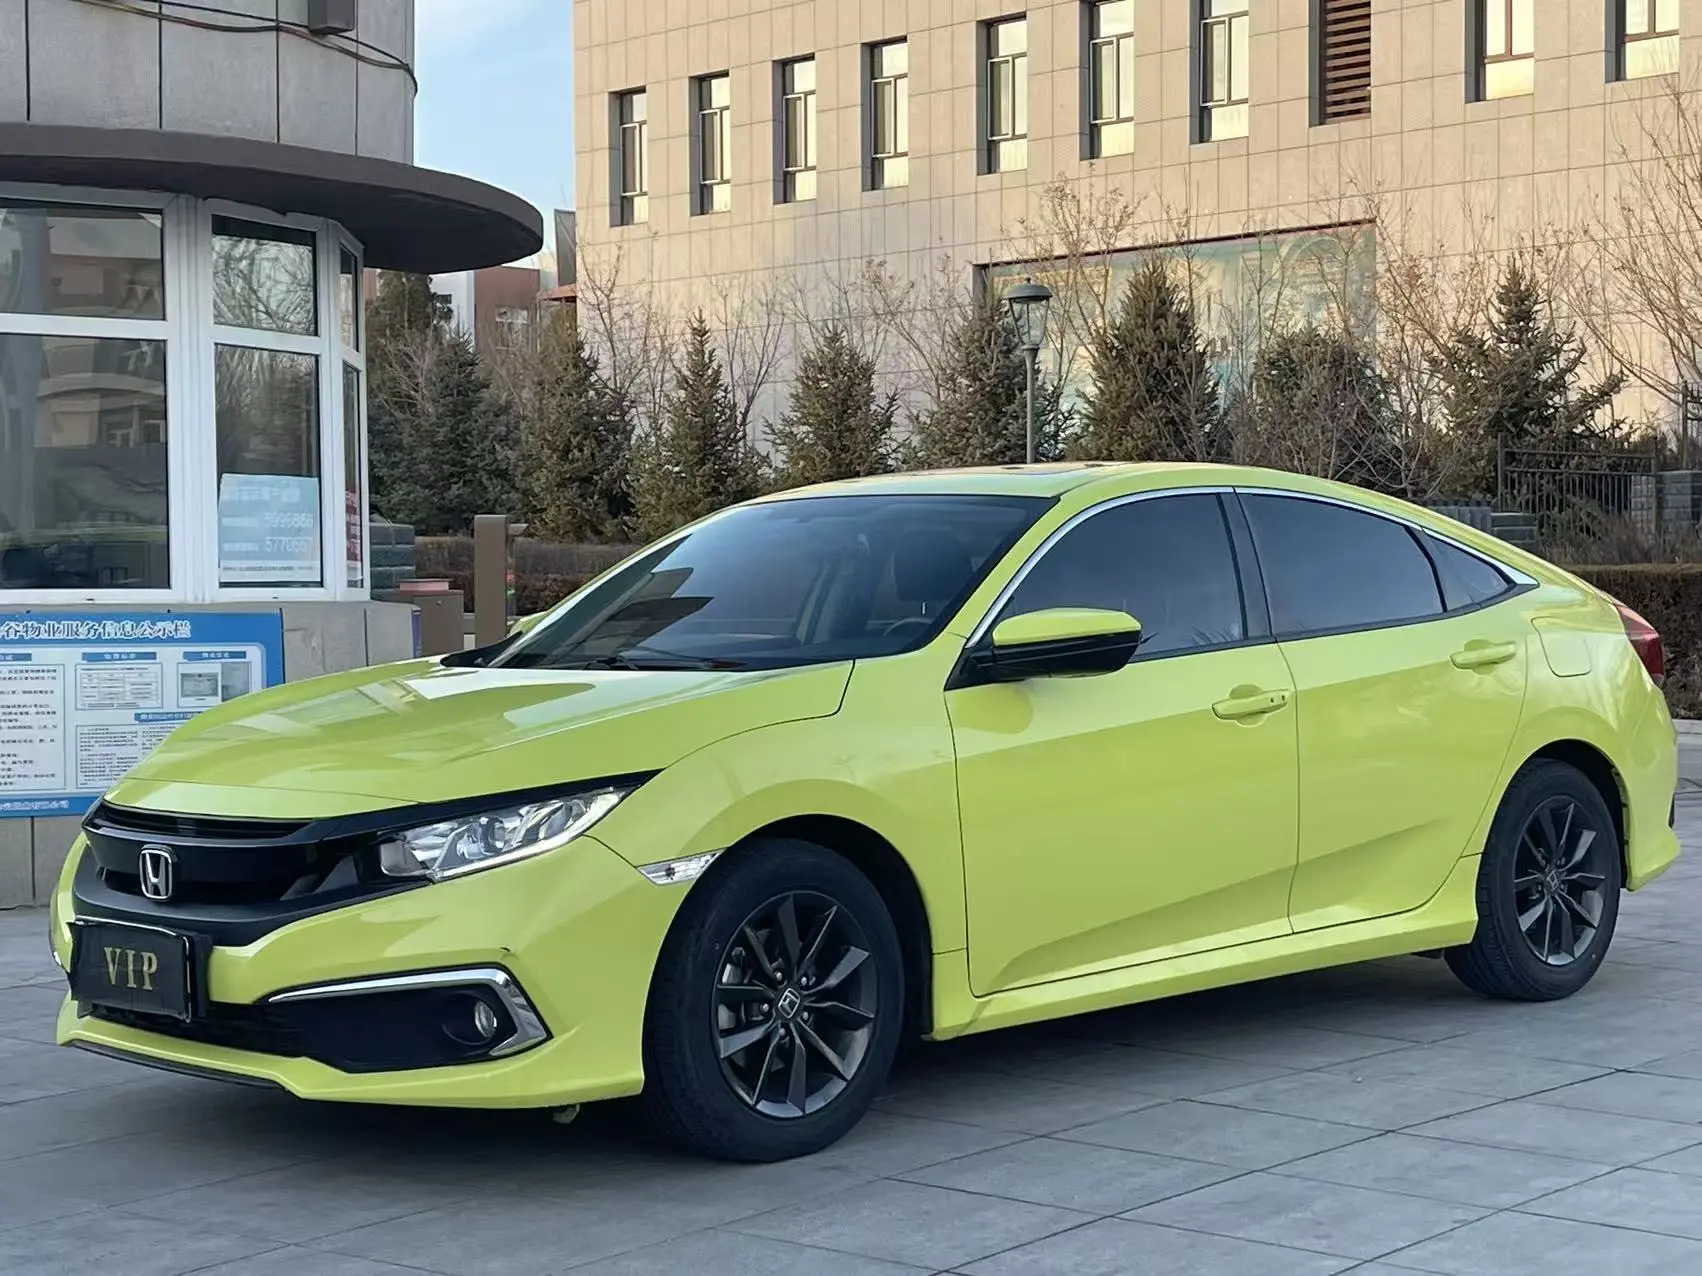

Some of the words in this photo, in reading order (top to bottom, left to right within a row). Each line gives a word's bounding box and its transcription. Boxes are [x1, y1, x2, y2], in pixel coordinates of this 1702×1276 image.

[0, 620, 191, 640] 谷物业服务信息公示栏
[104, 947, 158, 990] VIP
